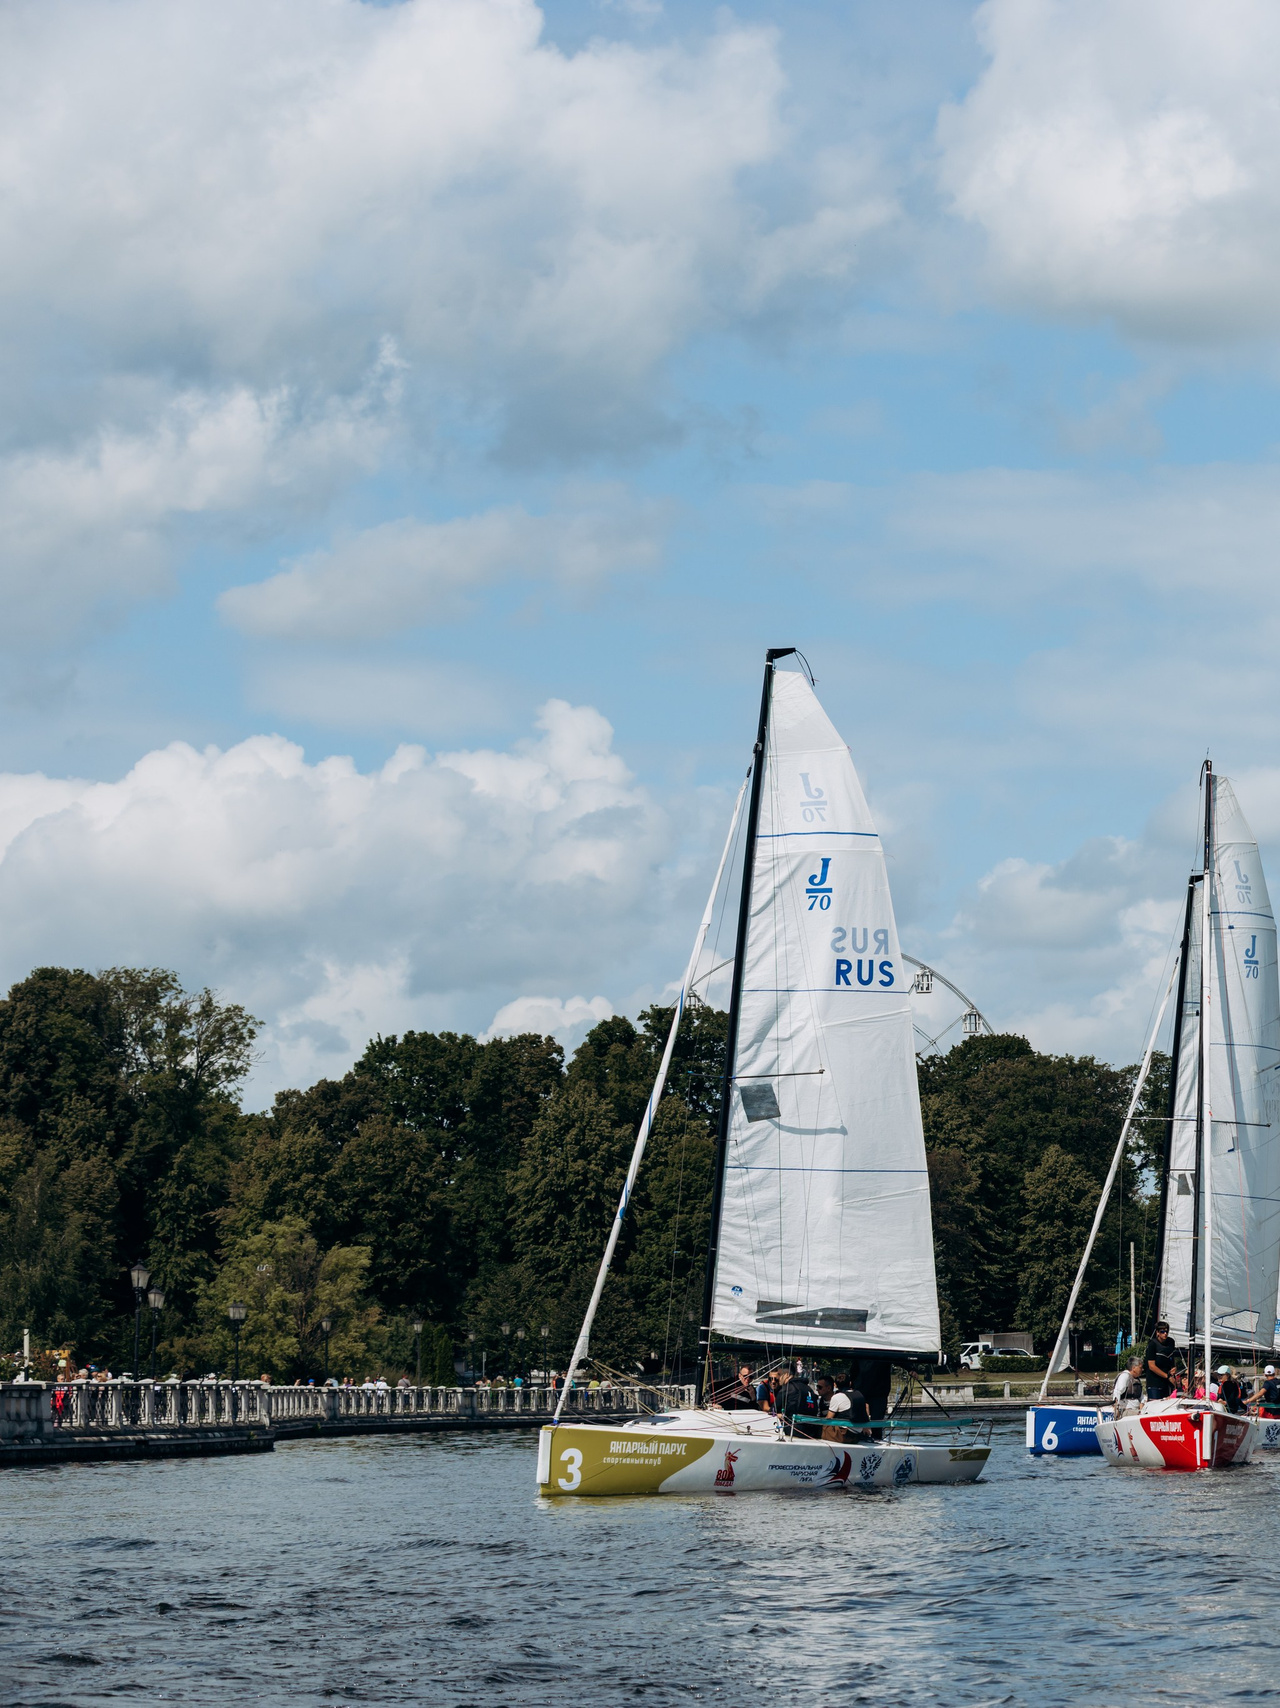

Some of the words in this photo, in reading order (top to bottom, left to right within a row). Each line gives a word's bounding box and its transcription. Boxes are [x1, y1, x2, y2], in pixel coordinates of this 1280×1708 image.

[808, 858, 832, 886] J
[807, 895, 832, 910] 70
[1245, 935, 1257, 958] J
[835, 959, 895, 987] RUS
[1245, 965, 1259, 979] 70
[609, 1440, 659, 1454] ЯНТАРНЫЙ
[659, 1443, 687, 1455] ПАРУС
[1042, 1421, 1058, 1451] 6
[1194, 1429, 1200, 1466] 1
[557, 1447, 583, 1491] 3
[603, 1457, 644, 1465] спортивный
[645, 1457, 662, 1466] клуб
